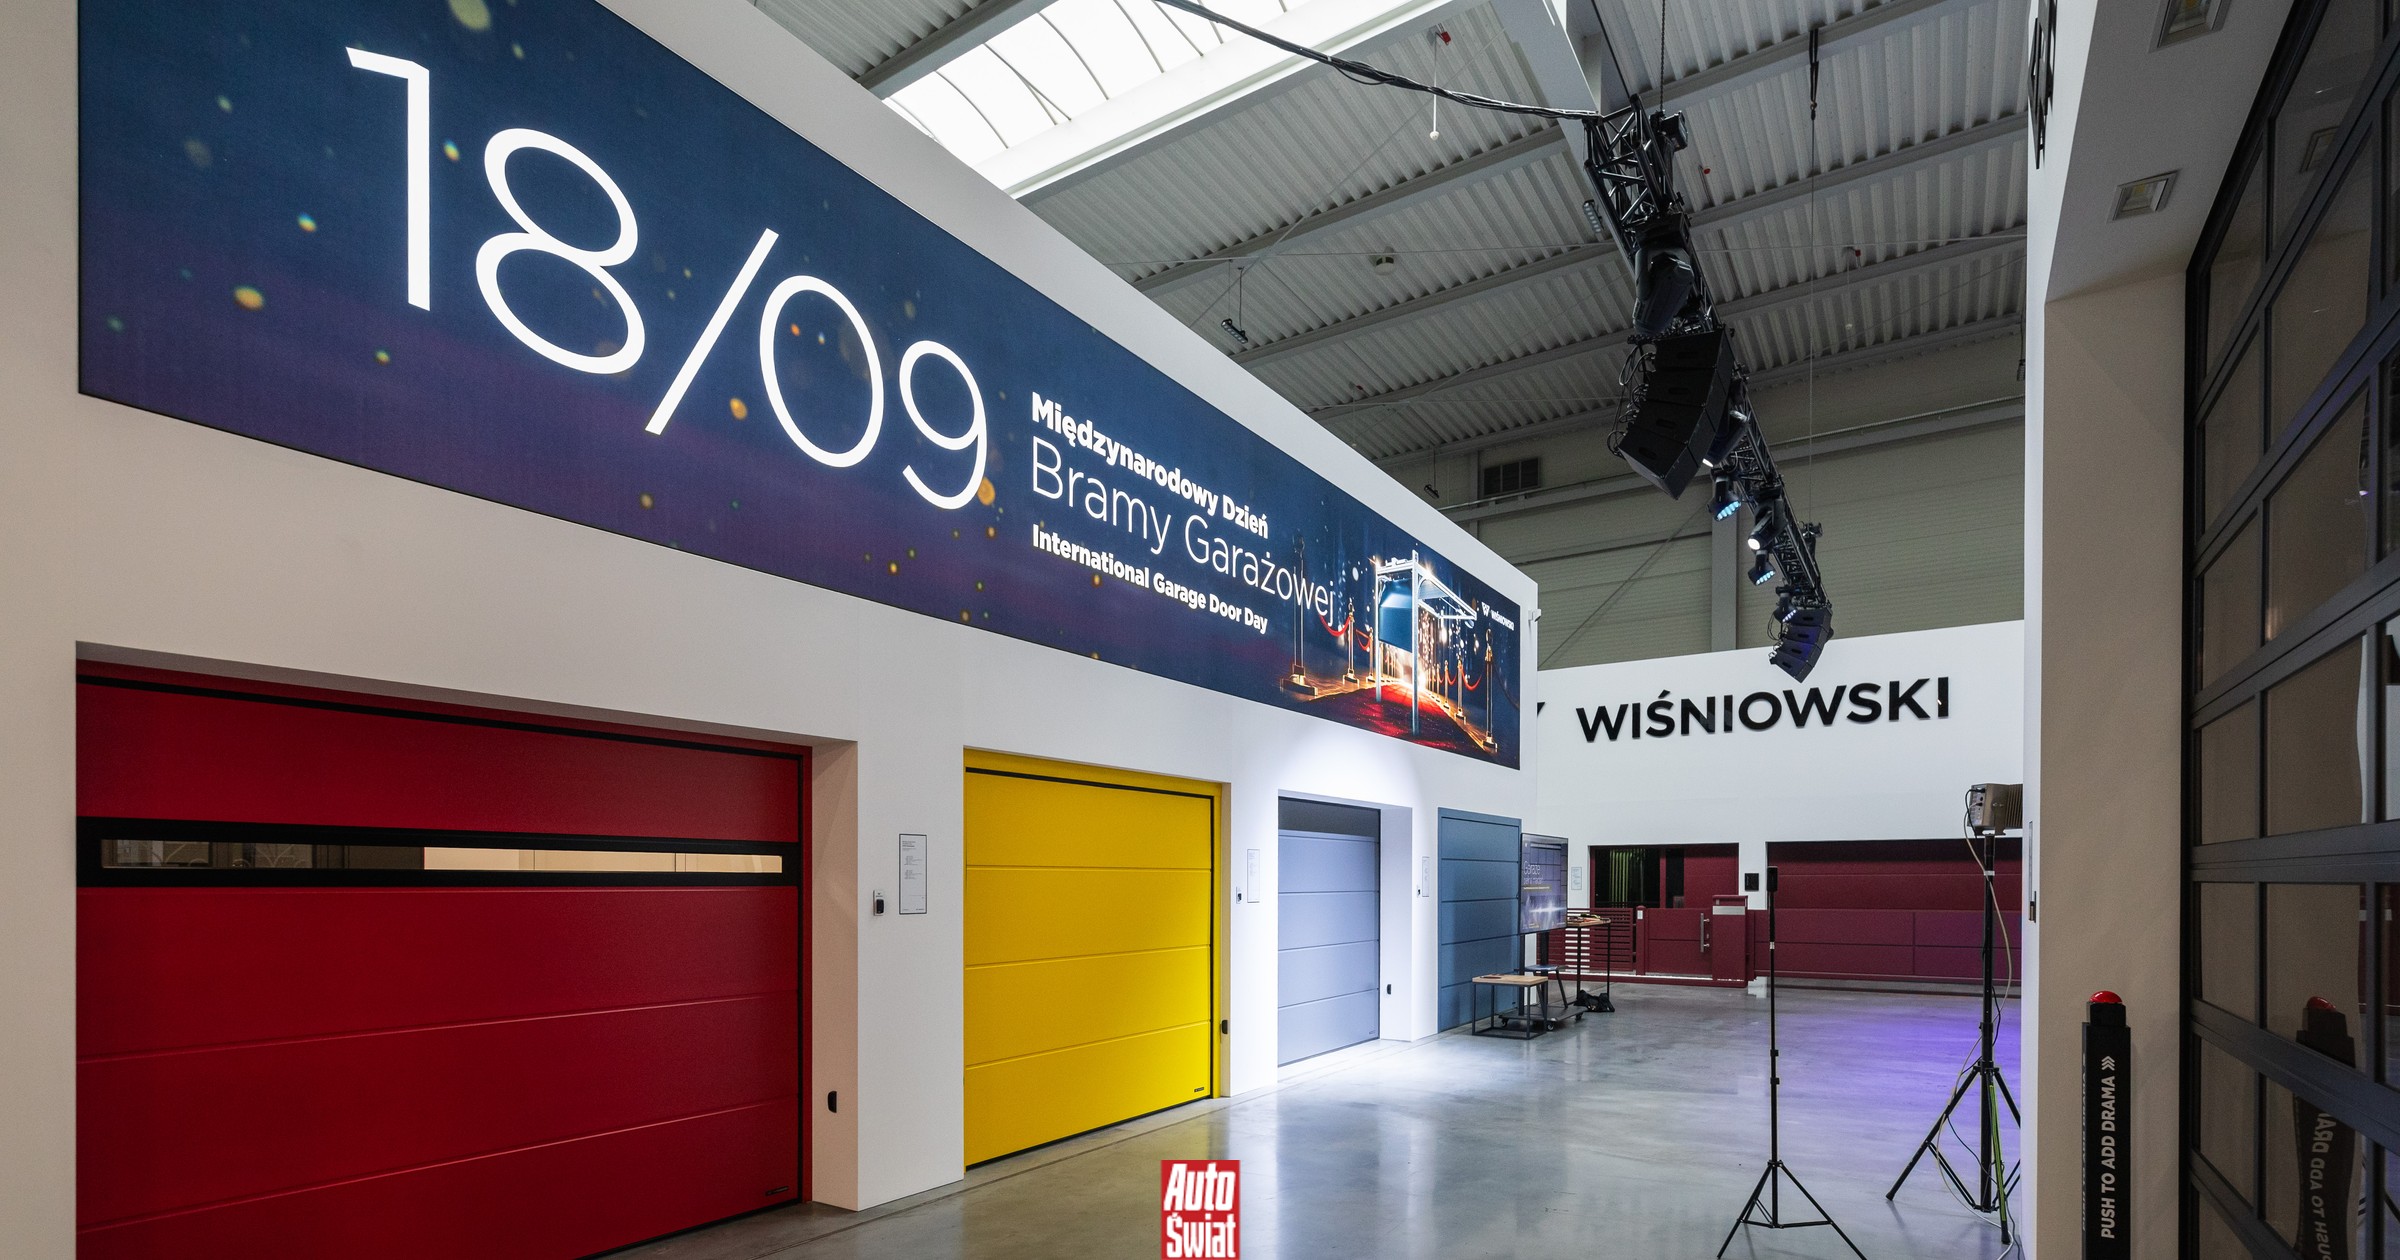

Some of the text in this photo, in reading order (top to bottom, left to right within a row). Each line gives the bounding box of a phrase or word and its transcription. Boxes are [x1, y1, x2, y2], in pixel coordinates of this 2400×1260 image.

[346, 46, 988, 510] 18/09
[1032, 391, 1269, 540] Międzynarodowy Dzień
[1032, 435, 1335, 627] Bramy Garażowej
[1032, 524, 1269, 635] International Garage Door Day
[1575, 676, 1950, 743] WIŚNIOWSKI
[2101, 1075, 2115, 1239] PUSH TO ADD DRAMA
